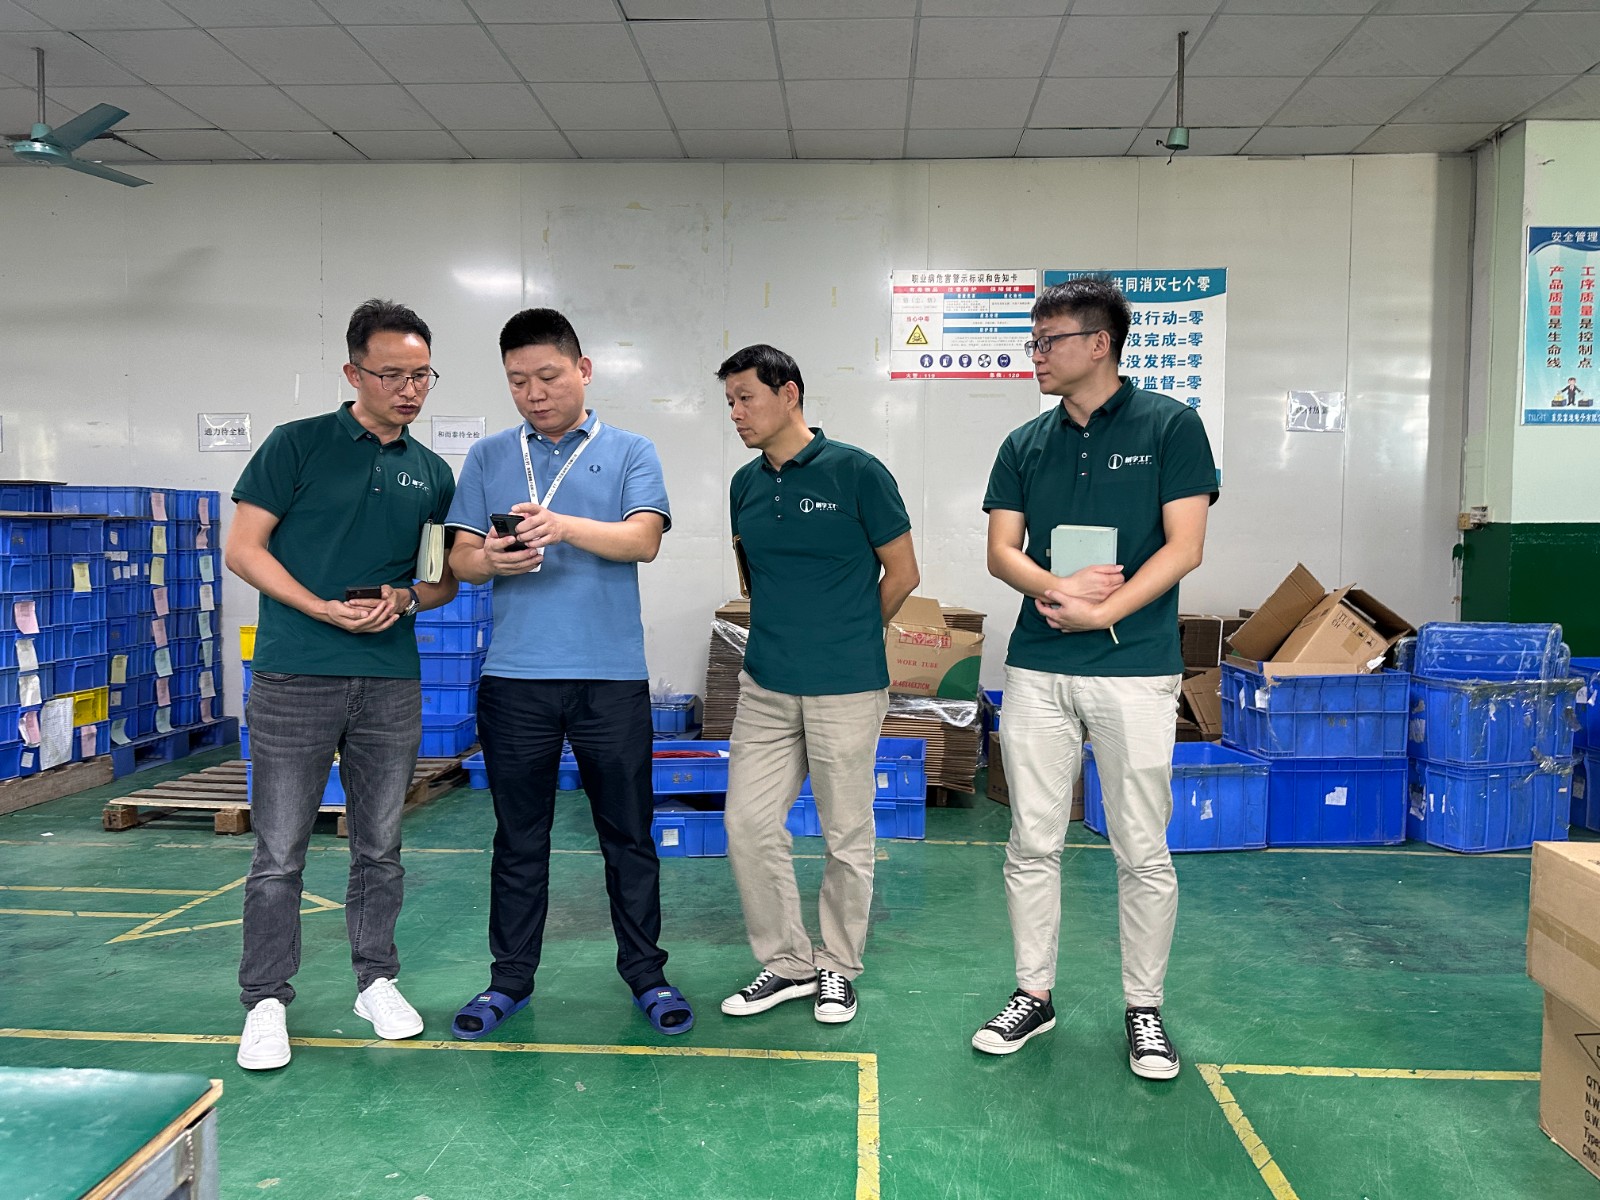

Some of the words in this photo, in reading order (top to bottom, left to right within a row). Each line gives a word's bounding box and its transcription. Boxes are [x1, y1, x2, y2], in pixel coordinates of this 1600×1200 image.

[1551, 231, 1598, 243] 安全管理
[911, 273, 1018, 284] 职业病危害警示标识和告知卡
[1546, 266, 1565, 369] 产品质量是生命线
[1577, 266, 1596, 369] 工序质量是控制点
[1126, 332, 1203, 347] 没完成=零
